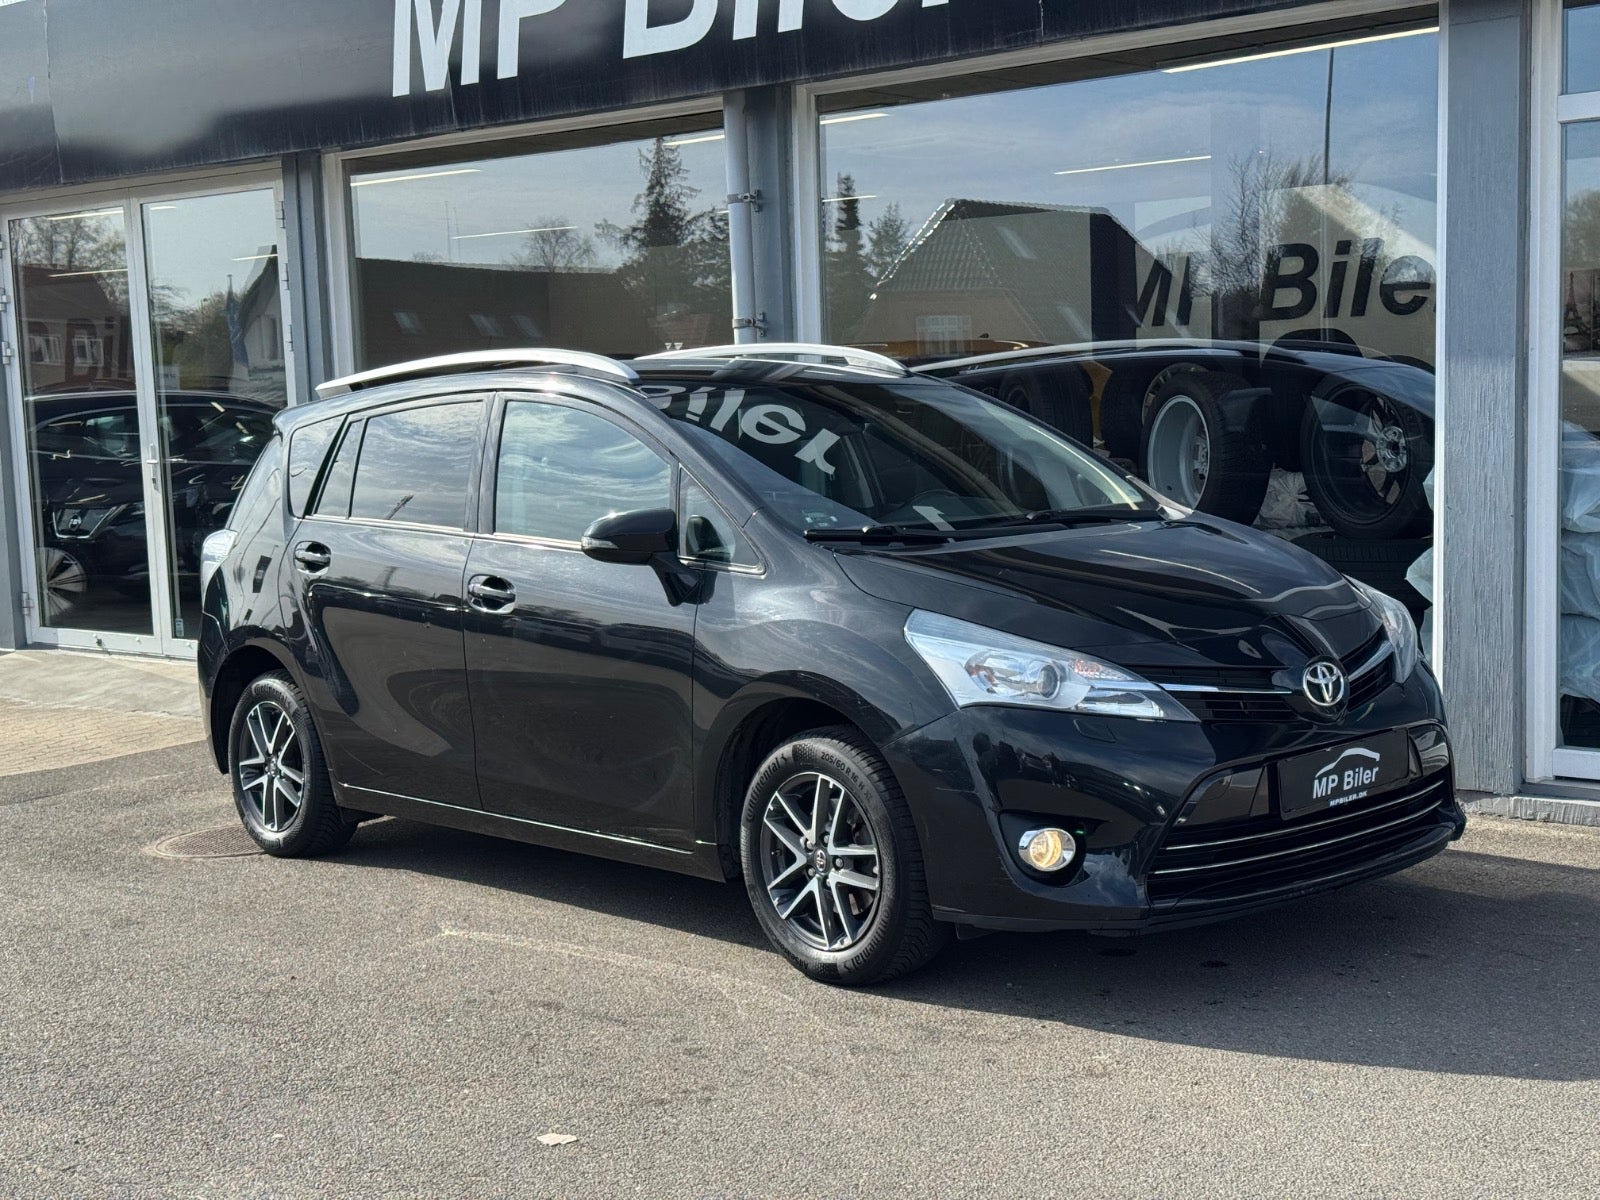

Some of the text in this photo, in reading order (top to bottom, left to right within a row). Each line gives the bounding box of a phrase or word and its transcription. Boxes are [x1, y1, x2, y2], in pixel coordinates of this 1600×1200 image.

[1259, 238, 1437, 321] Bile
[820, 751, 846, 771] 205/60
[845, 767, 852, 776] R
[746, 756, 781, 822] Continental
[1312, 766, 1379, 799] MP Biler
[1329, 790, 1368, 807] MPBILER.DK
